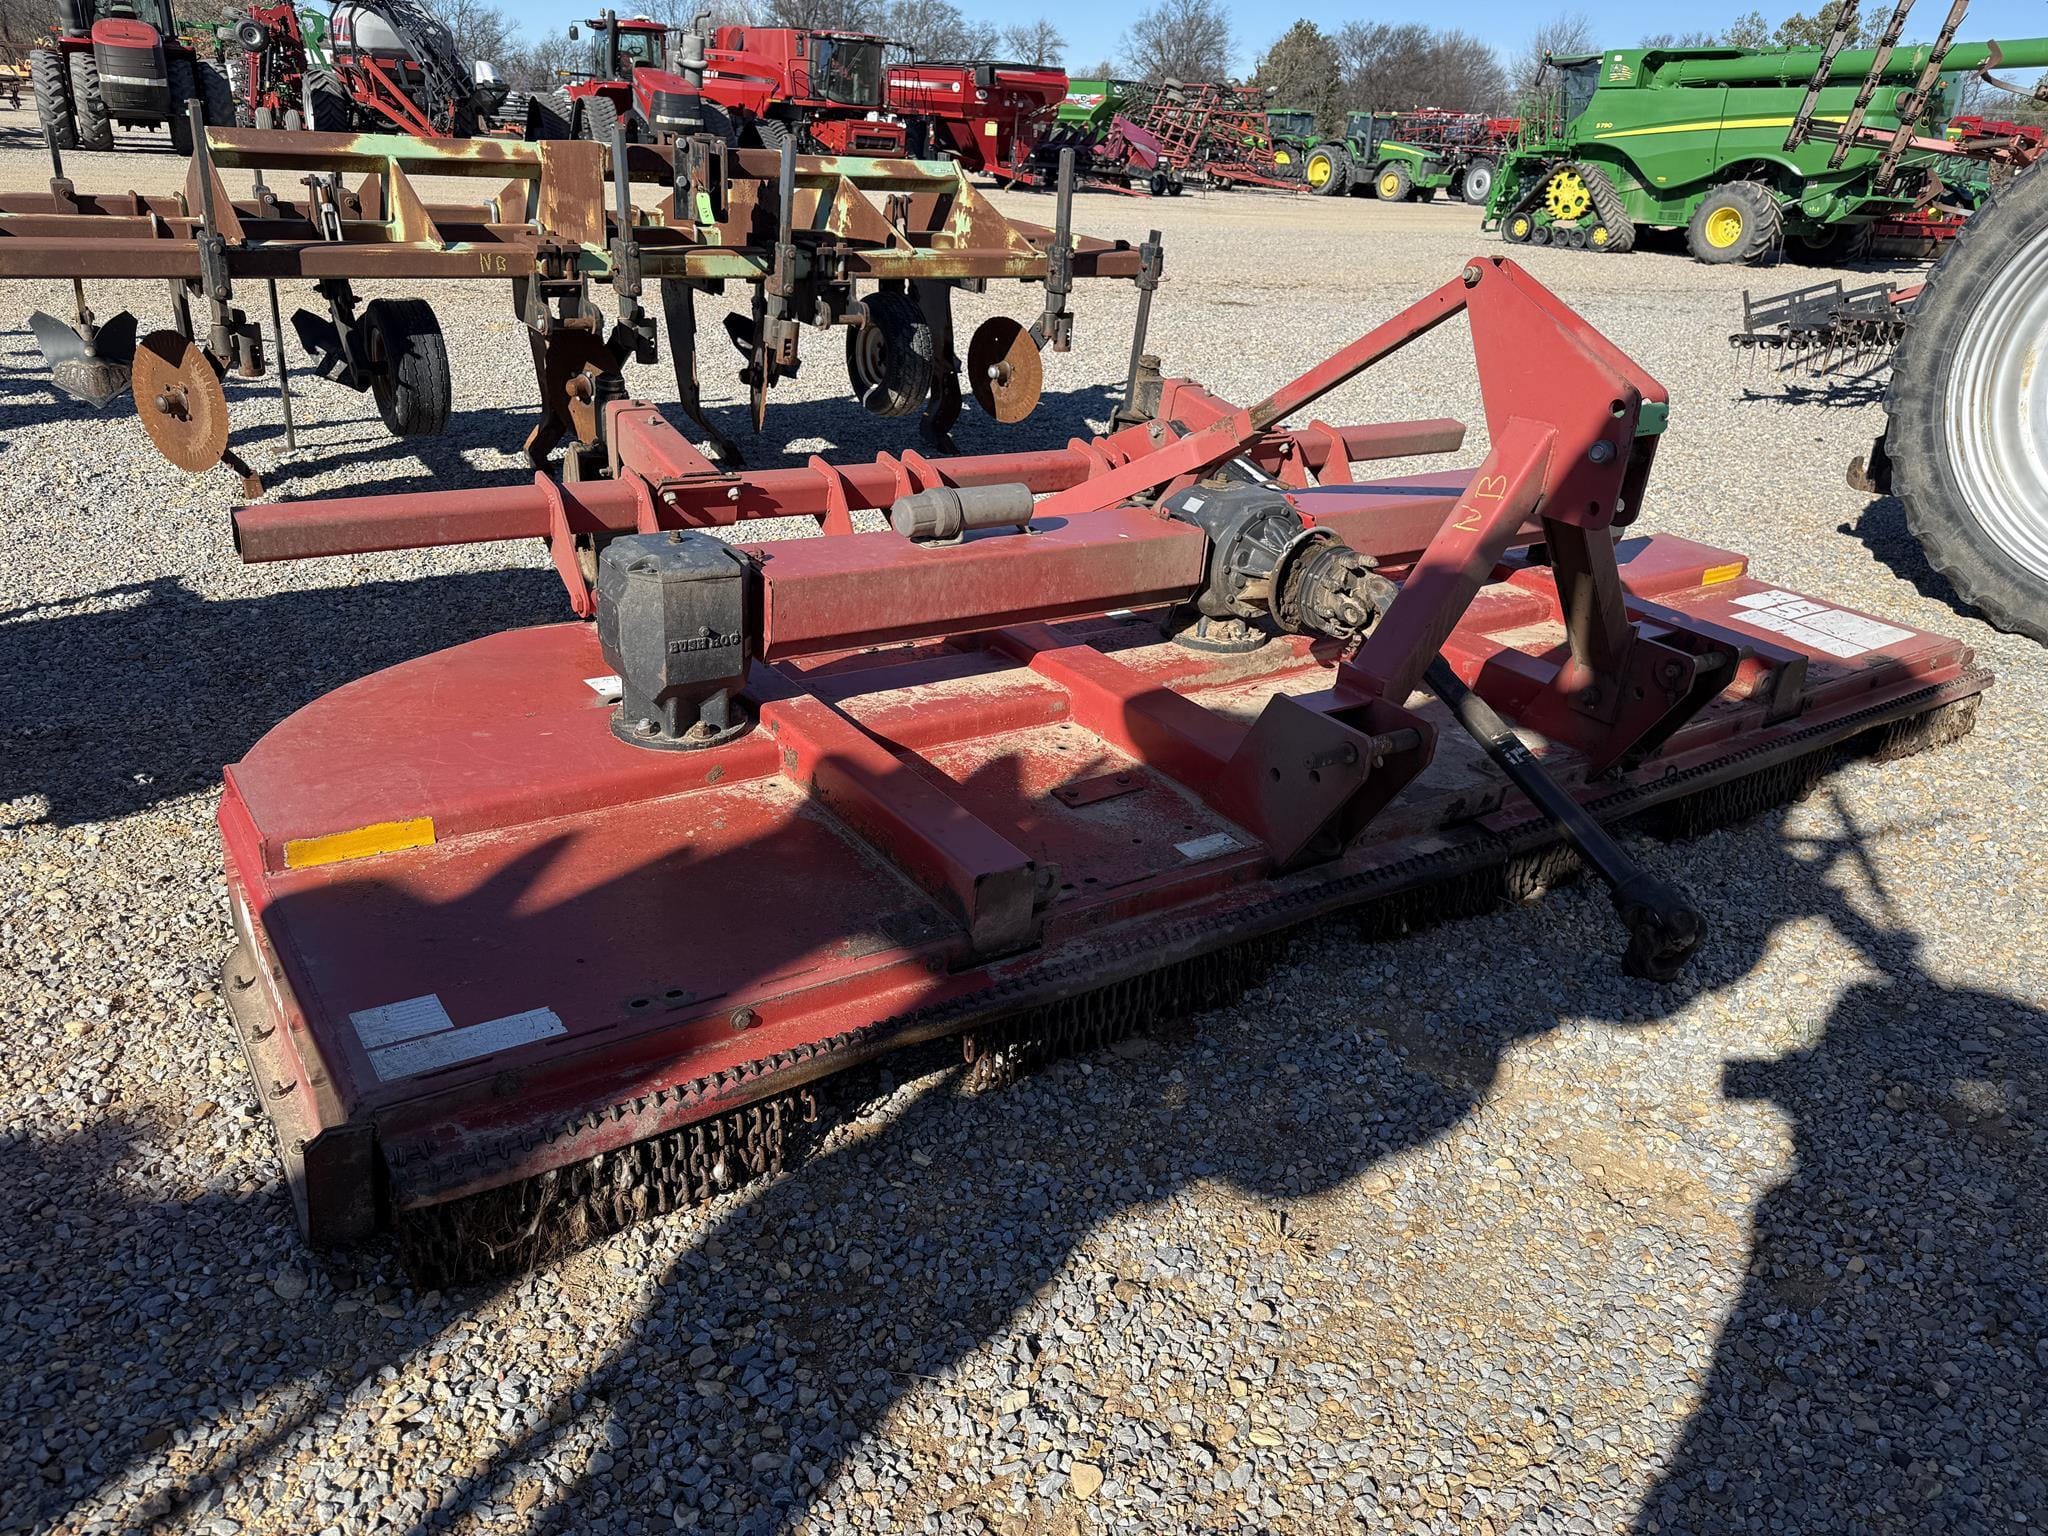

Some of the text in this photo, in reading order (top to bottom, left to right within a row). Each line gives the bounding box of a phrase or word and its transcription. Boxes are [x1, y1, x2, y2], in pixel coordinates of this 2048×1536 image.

[1452, 474, 1507, 532] NB
[668, 630, 742, 654] BUSH HOG
